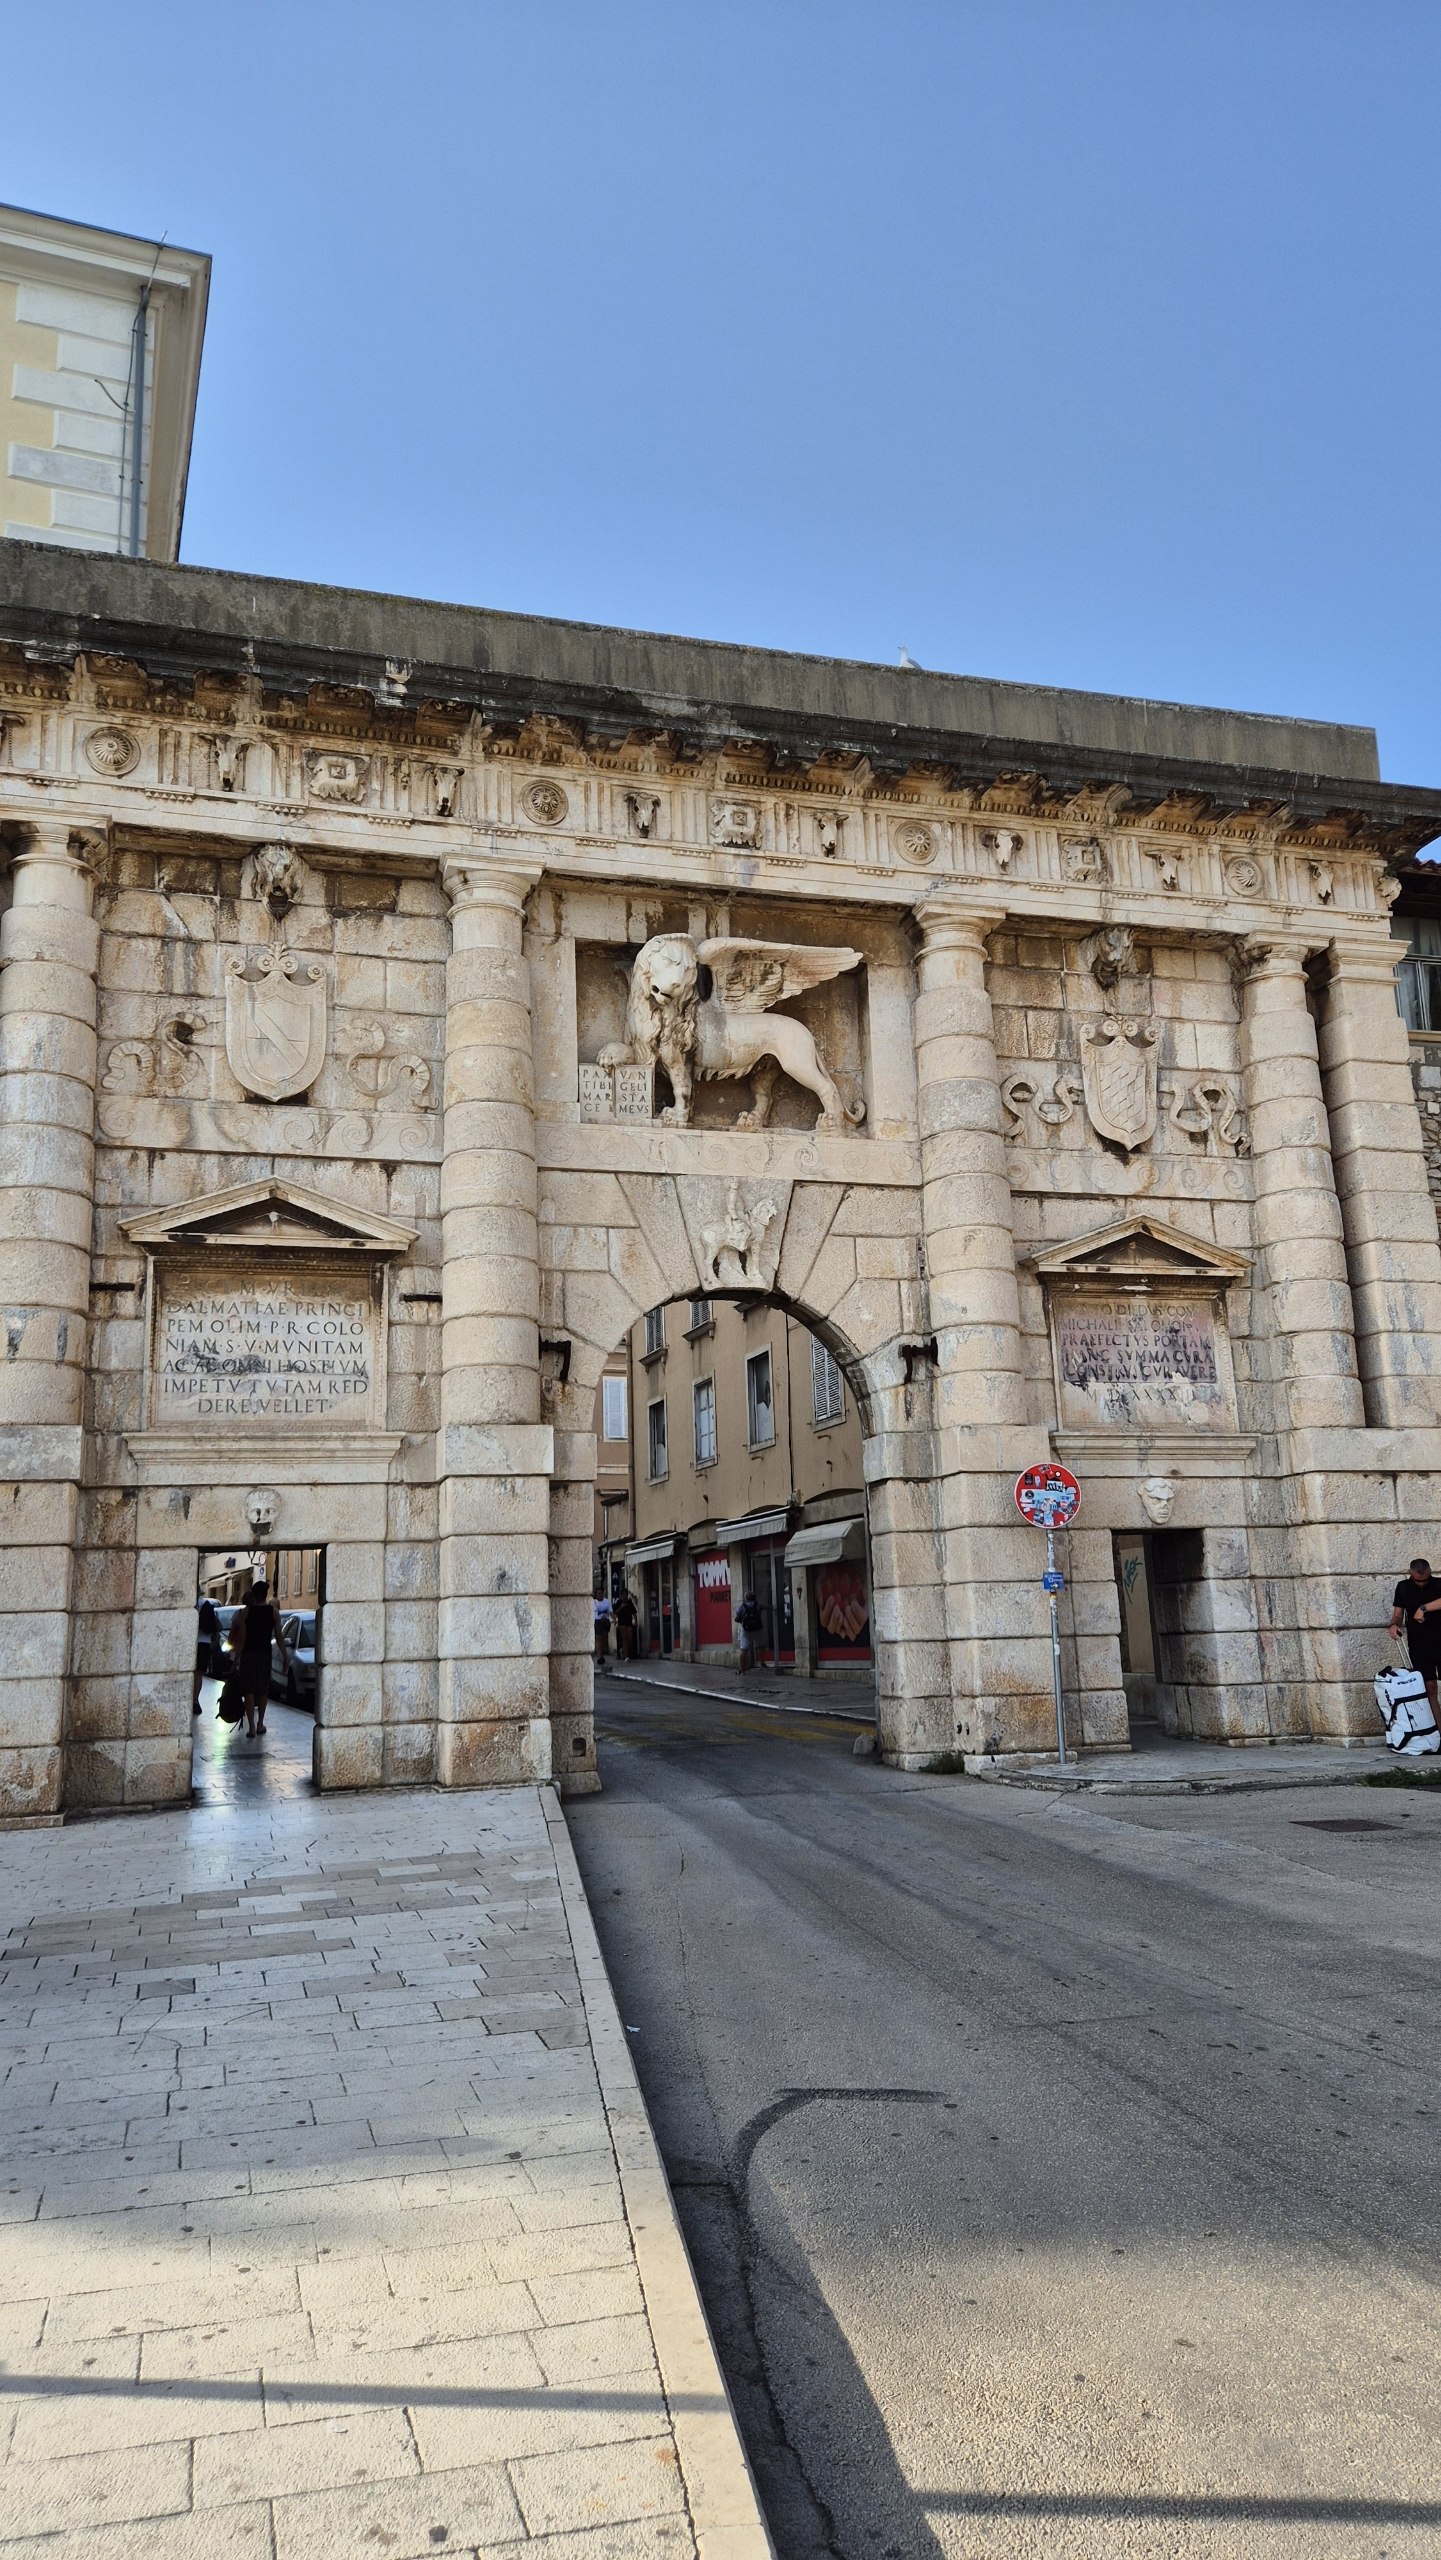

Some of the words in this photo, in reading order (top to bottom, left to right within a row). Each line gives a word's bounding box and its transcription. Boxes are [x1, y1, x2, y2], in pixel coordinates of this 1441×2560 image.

[583, 1070, 612, 1079] PAX
[620, 1070, 646, 1080] VAN
[583, 1081, 612, 1090] TIBI
[620, 1082, 647, 1092] GELI
[583, 1092, 612, 1101] MAR
[621, 1094, 646, 1103] STA
[619, 1105, 649, 1114] MEVS
[295, 1302, 363, 1316] PRINCI
[167, 1319, 203, 1333] PEM
[210, 1320, 261, 1334] OLIM
[306, 1321, 364, 1336] COLO
[165, 1338, 220, 1354] NIAM
[264, 1340, 363, 1354] MVNITAM
[164, 1379, 241, 1393] IMPETV
[328, 1380, 368, 1394] RED
[198, 1398, 250, 1413] DERE
